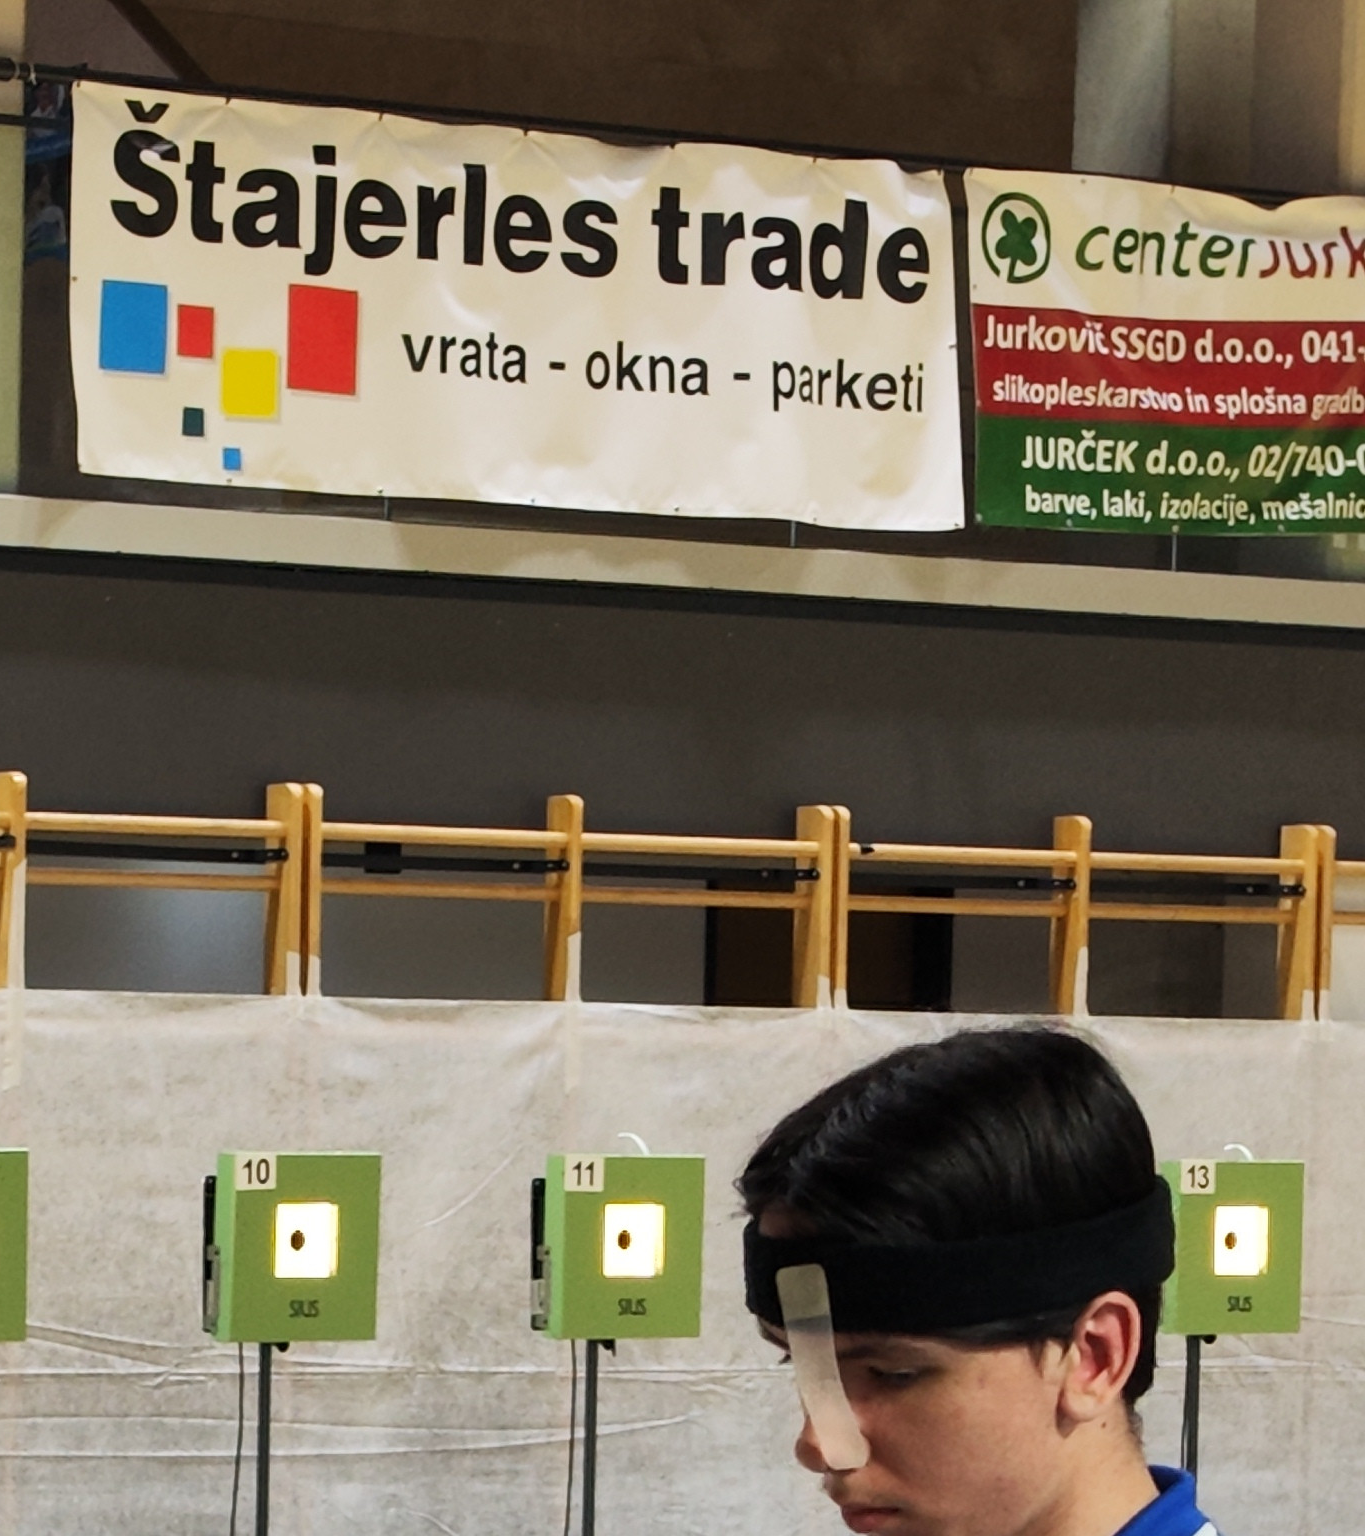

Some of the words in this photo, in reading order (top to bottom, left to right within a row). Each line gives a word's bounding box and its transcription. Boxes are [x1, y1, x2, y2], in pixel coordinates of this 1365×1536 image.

[109, 99, 619, 277] Štajerles
[651, 186, 931, 304] trade
[983, 314, 1109, 355] Jurkovič
[1110, 326, 1186, 362] SSGD
[1194, 330, 1293, 369] d.o.o.,
[401, 331, 527, 385] vrata
[585, 341, 709, 397] okna
[771, 359, 925, 415] parketi
[992, 374, 1183, 413] slikopleskarstvo
[1185, 386, 1209, 413] in
[1215, 386, 1307, 420] splošna
[1022, 429, 1138, 474] JURČEK
[1146, 440, 1240, 482] d.o.o.,
[1025, 485, 1097, 520] barve,
[1103, 489, 1152, 523] laki,
[1160, 492, 1255, 526] izolacije,
[242, 1158, 269, 1184] 10
[572, 1161, 594, 1186] 11
[1187, 1165, 1209, 1189] 13
